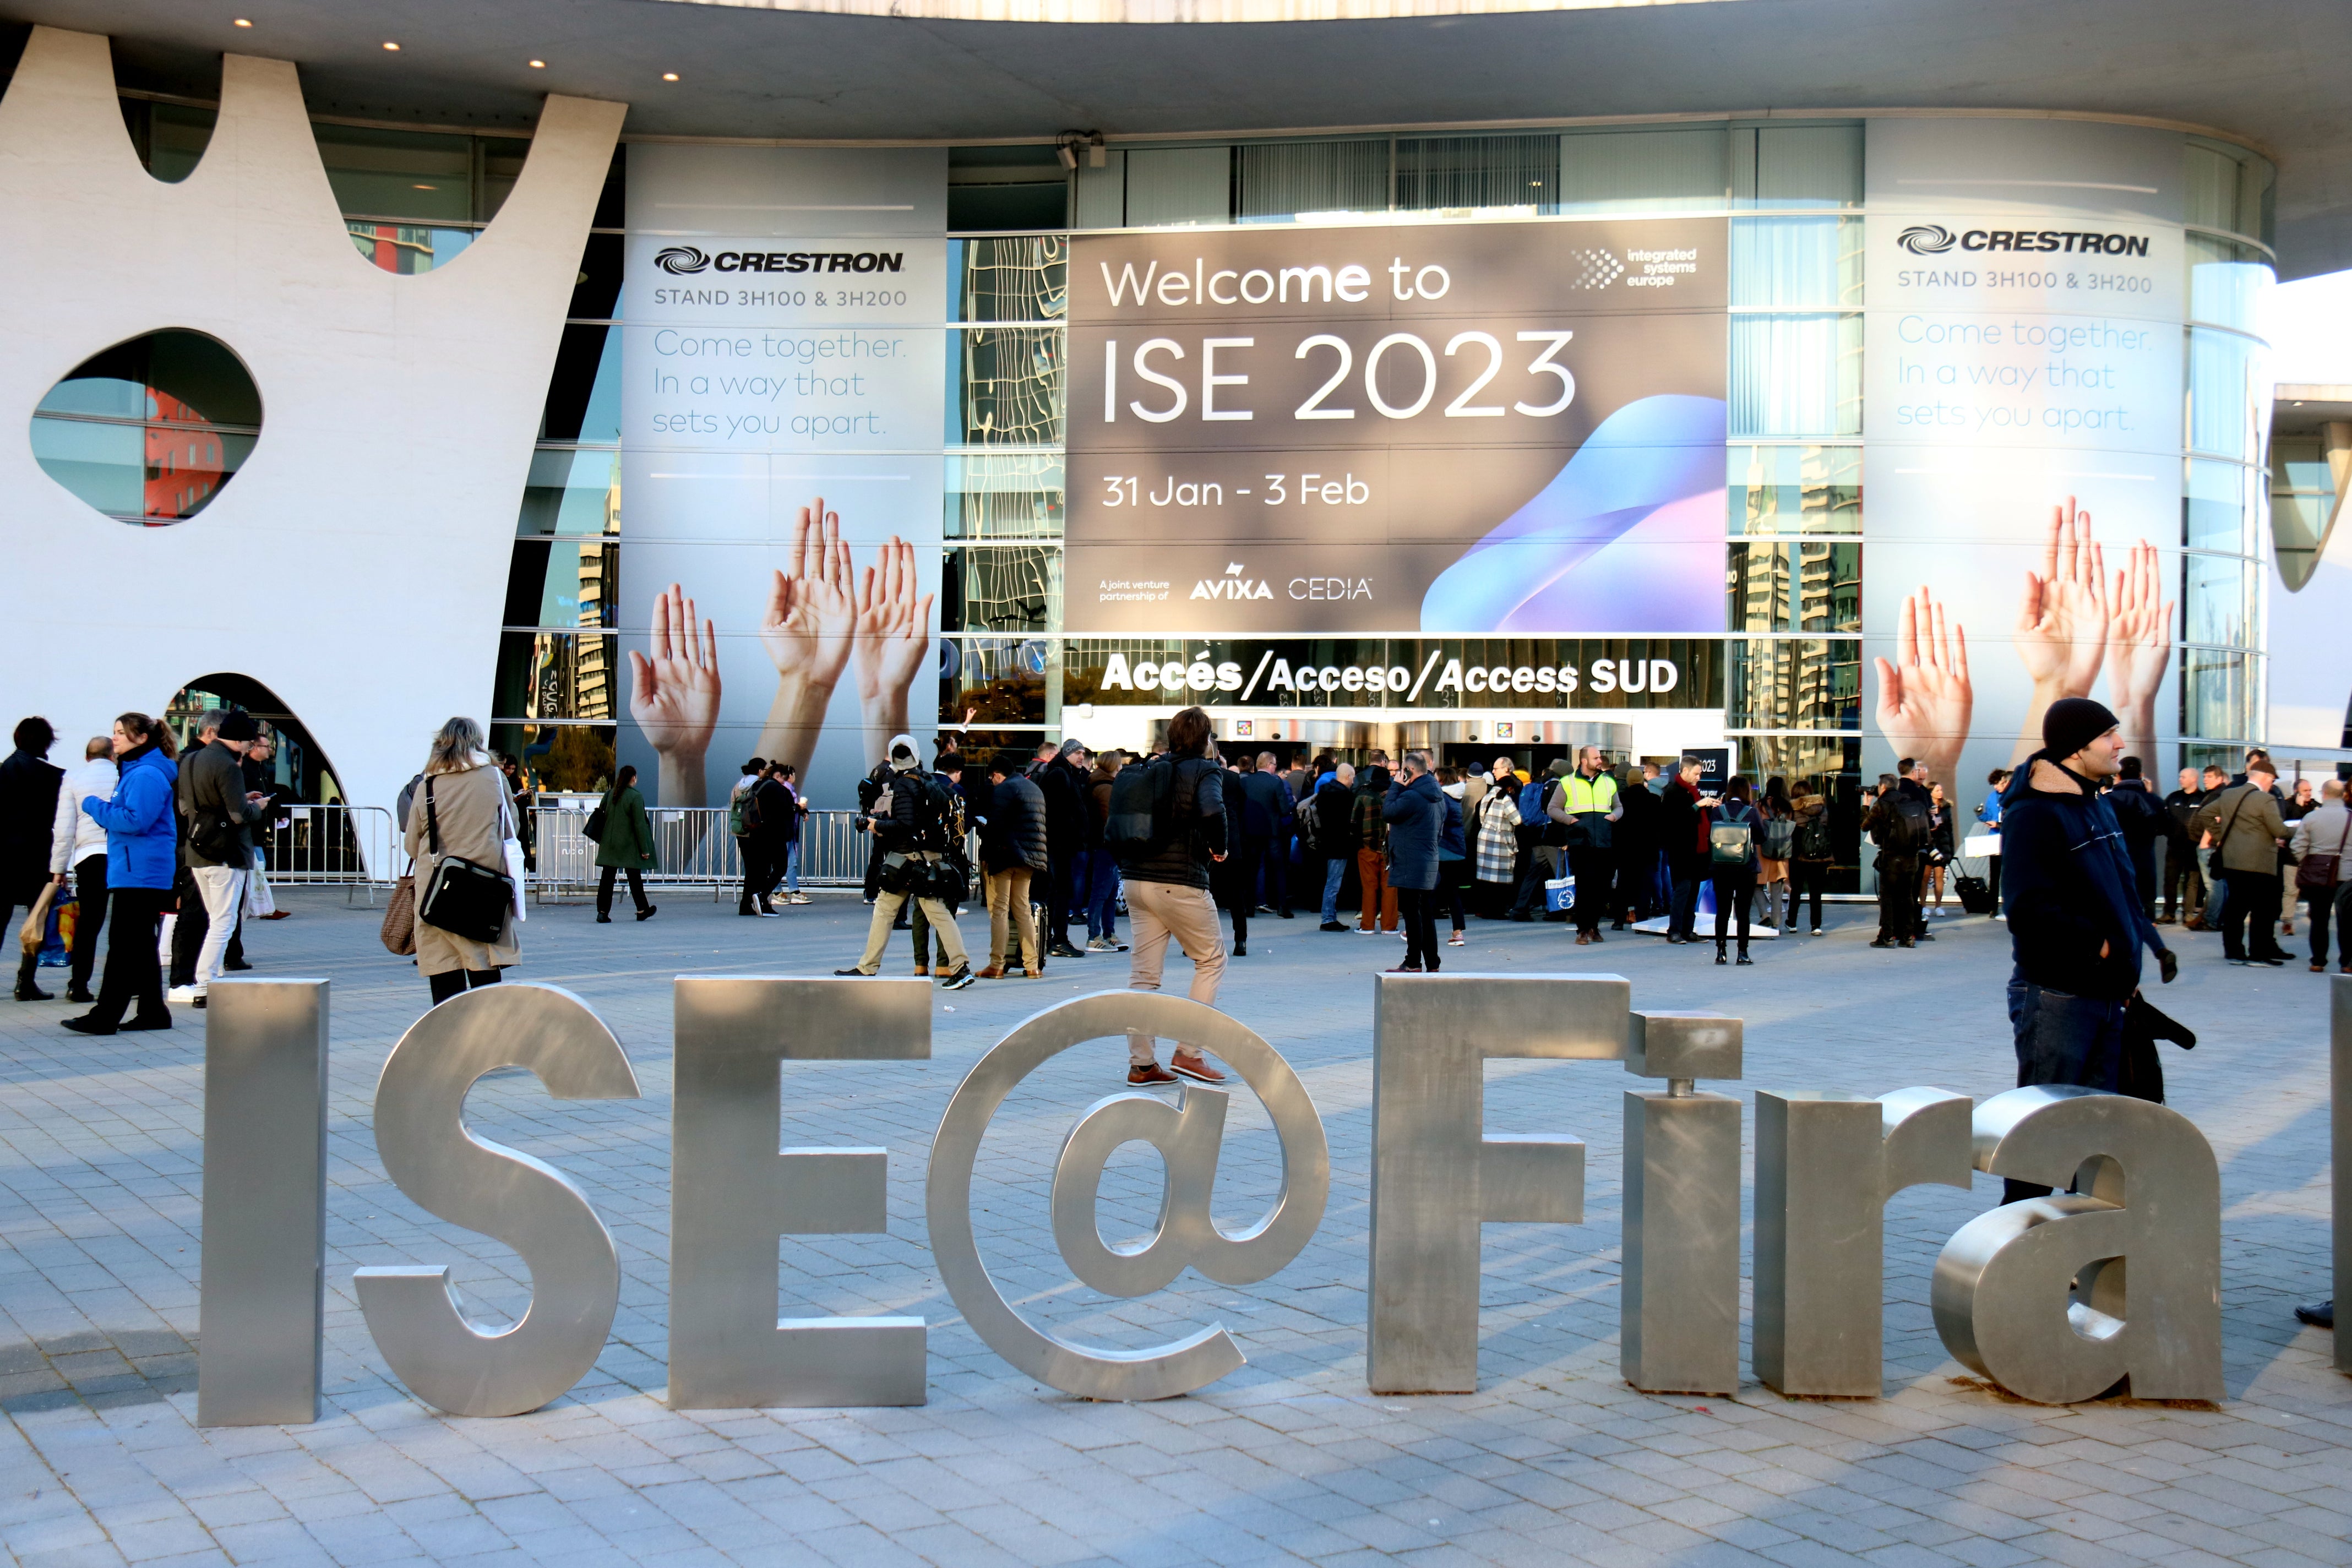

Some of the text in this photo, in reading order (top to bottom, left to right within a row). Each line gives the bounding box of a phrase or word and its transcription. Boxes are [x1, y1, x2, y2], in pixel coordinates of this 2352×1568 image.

[1627, 248, 1697, 263] integrated
[1961, 230, 2149, 257] CRESTRON
[714, 252, 904, 274] CRESTRON
[1643, 262, 1697, 275] systems
[1100, 257, 1450, 307] Welcome to
[1627, 275, 1674, 288] europe
[1898, 270, 2152, 294] STAND 3H100 & 3H200
[654, 289, 907, 307] STAND 3H100 & 3H200
[654, 329, 907, 364] Come together.
[1898, 315, 2152, 353] Come together.
[655, 368, 865, 402] In a way that
[1104, 331, 1576, 423] ISE 2023
[1898, 356, 2115, 393] In a way that
[652, 409, 886, 440] sets you apart.
[1897, 400, 2135, 435] sets you apart.
[1102, 476, 1137, 507] 31
[1149, 476, 1222, 507] Jan
[1264, 474, 1287, 505] 3
[1301, 472, 1370, 505] Feb
[1099, 579, 1170, 592] A joint venture
[1099, 590, 1169, 603] partnership of
[1189, 579, 1274, 600] AVIXA
[1590, 658, 1678, 694] SUD
[1699, 760, 1716, 772] 023
[1697, 788, 1708, 798] eep
[198, 971, 2223, 1428] ISE@Fira
